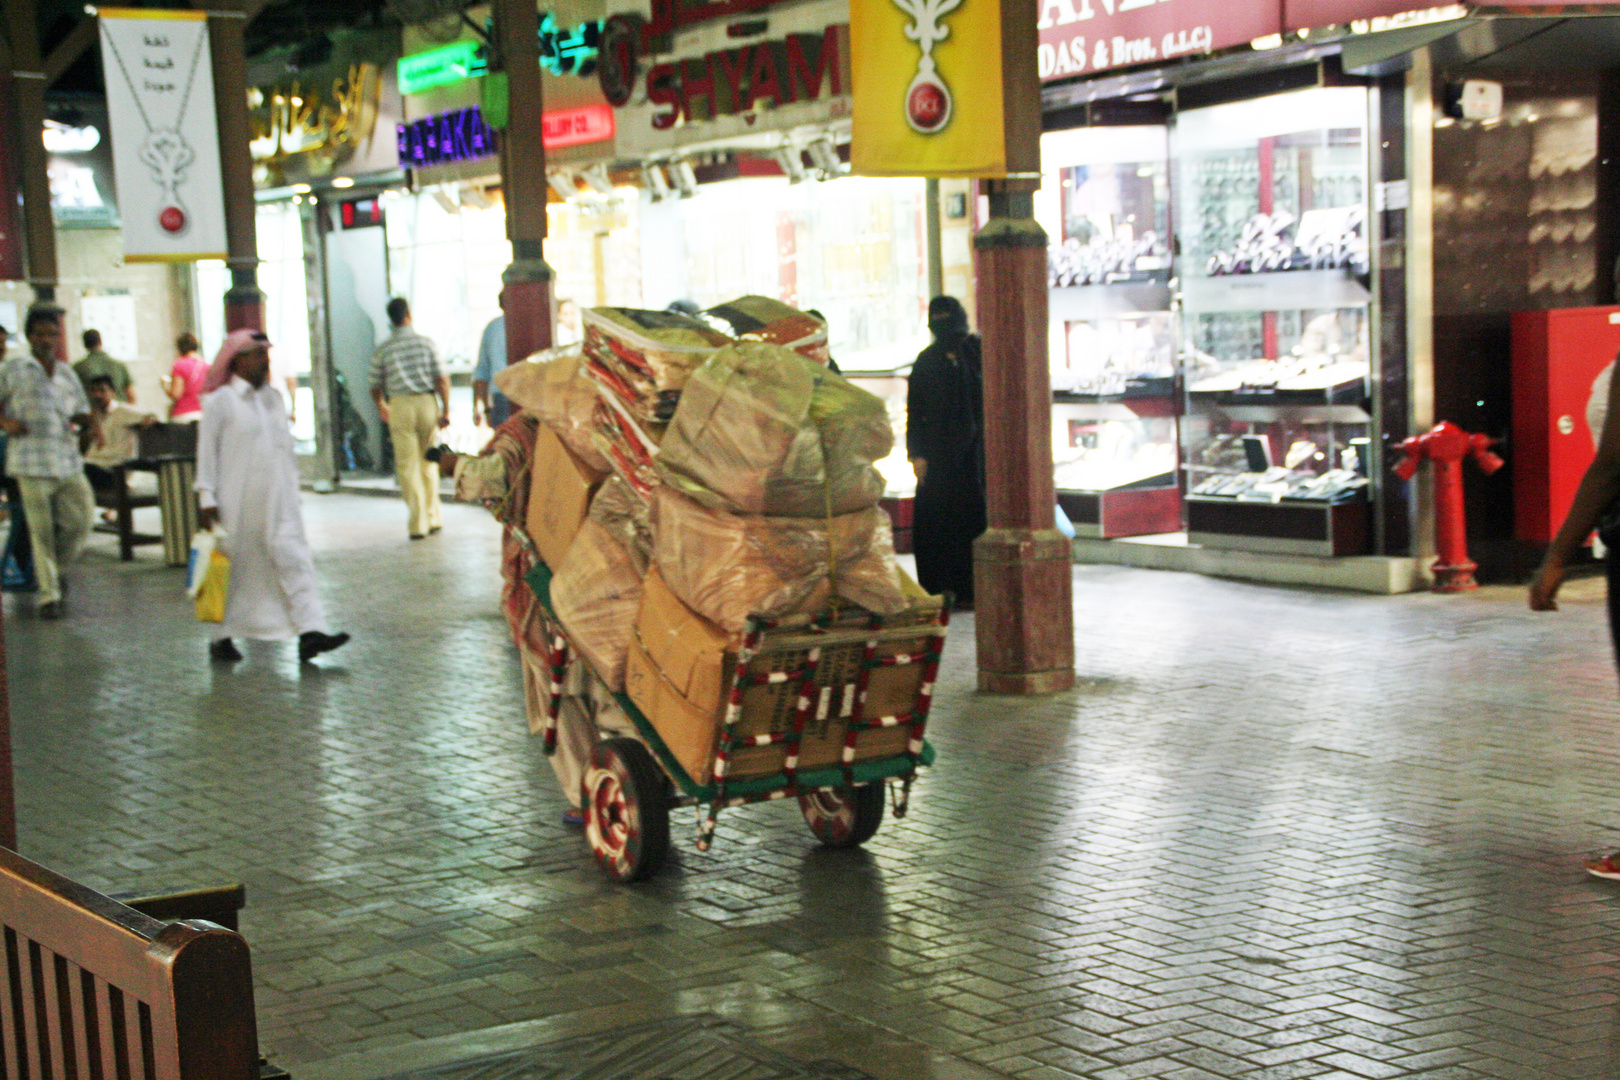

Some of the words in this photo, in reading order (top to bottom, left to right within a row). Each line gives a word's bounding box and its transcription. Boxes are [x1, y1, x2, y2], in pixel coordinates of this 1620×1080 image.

[647, 23, 841, 130] SHYAM
[1037, 36, 1087, 78] DAS
[1092, 39, 1109, 70] &
[1111, 35, 1157, 66] Bros.
